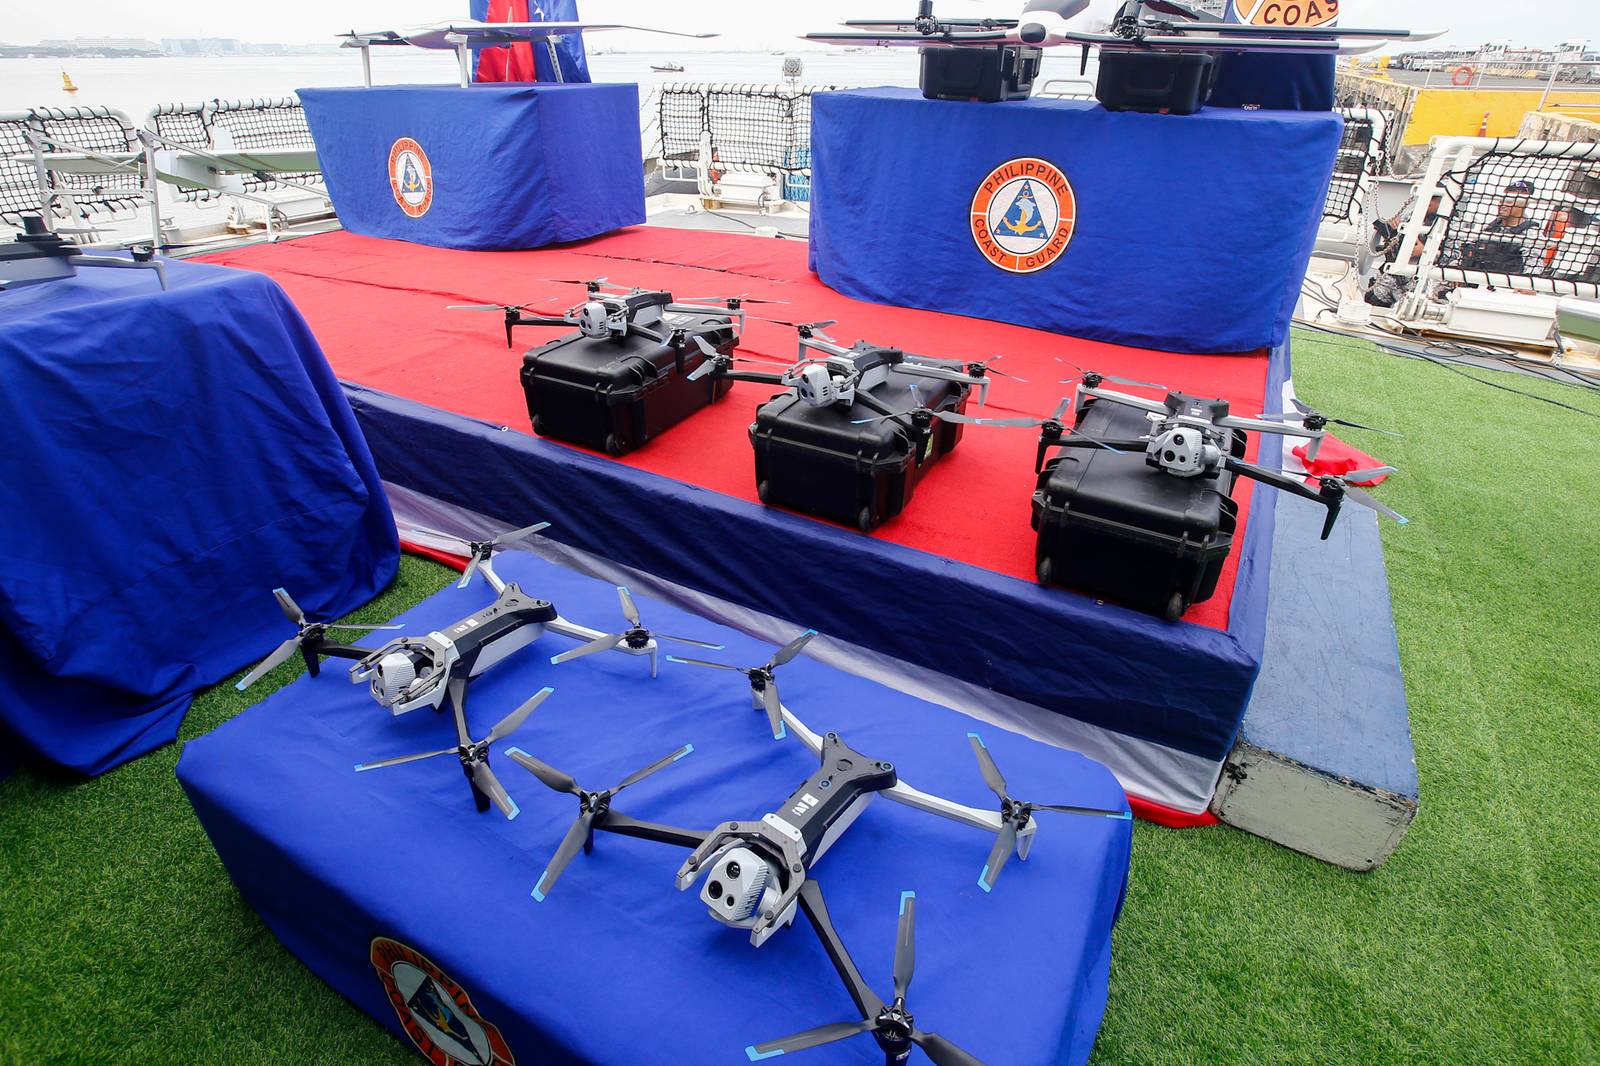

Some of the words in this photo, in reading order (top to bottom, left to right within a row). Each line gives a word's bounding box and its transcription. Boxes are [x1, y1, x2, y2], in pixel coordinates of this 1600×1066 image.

[984, 162, 1068, 197] PHILIPPINE
[974, 218, 1007, 263] COAST
[1025, 227, 1069, 268] GUARD
